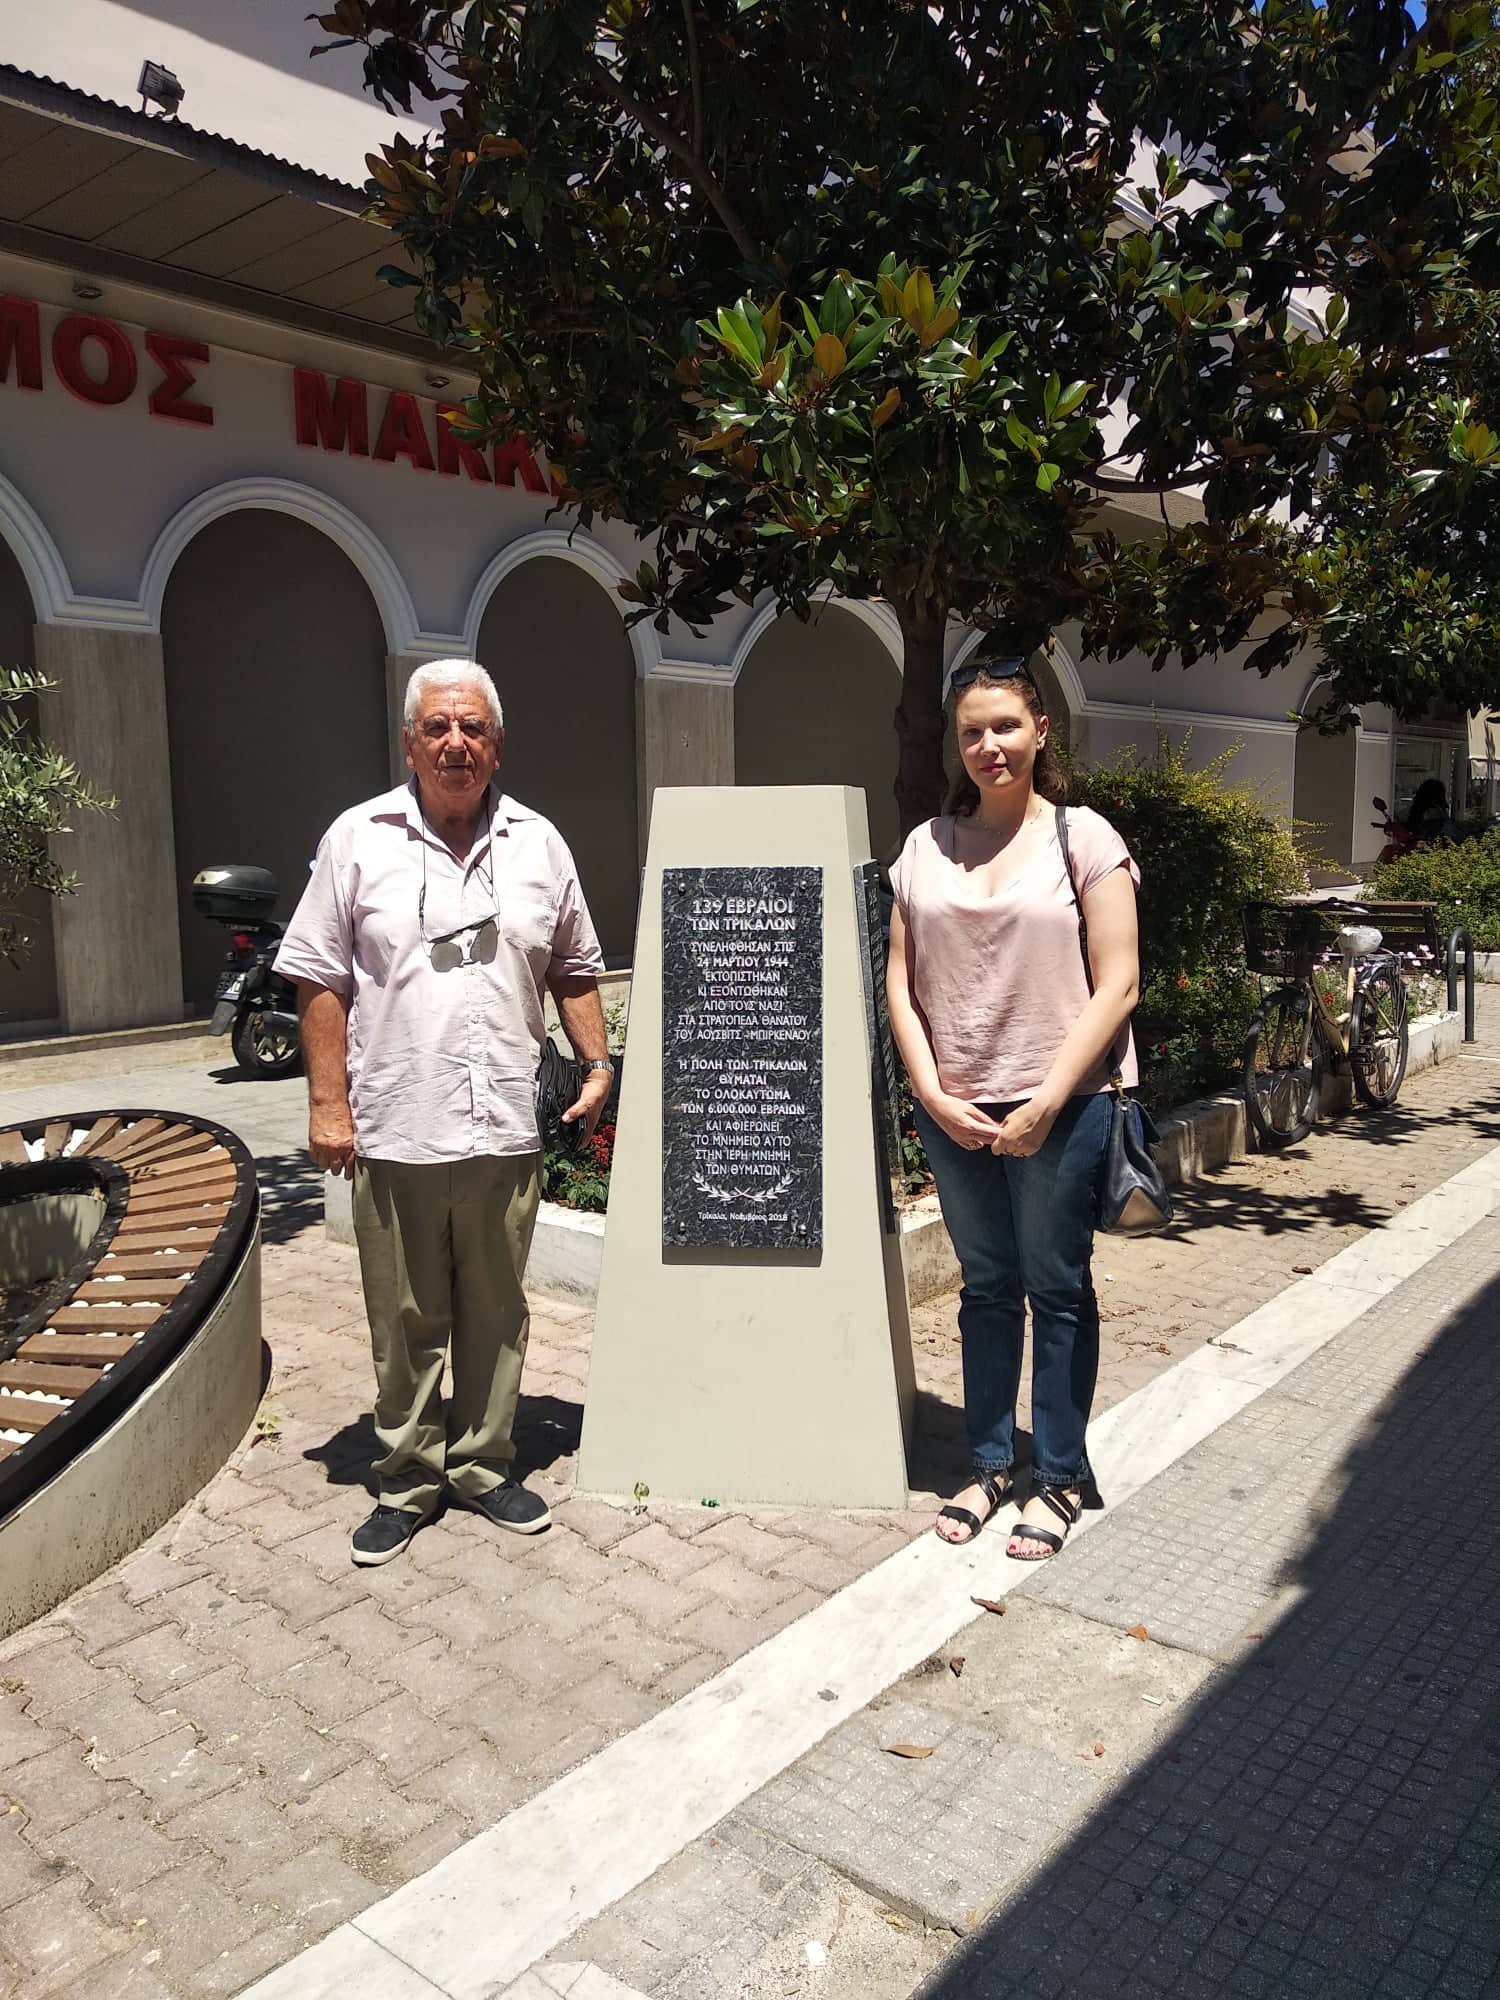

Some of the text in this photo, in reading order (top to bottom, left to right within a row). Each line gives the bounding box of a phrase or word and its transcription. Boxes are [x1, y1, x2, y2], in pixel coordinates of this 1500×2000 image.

[693, 898, 793, 914] 139 ΕΒΡΑΙΟΙ
[691, 918, 796, 930] ΤΩΝ ΤΡΙΚΑΛΩΝ
[690, 941, 795, 952] ΣΥΝΕΛΗΦΘΗΣΑΝ ΣΤΙΣ
[697, 957, 789, 967] 24 ΜΑΡΤΙΟΥ 1944
[705, 971, 780, 982] ΕΚΤΟΠΙΣΤΗΚΑΝ
[697, 986, 788, 996] ΚΙ ΕΞΟΝΤΩΘΗΚΑΝ
[703, 1000, 783, 1011] ΑΠΟ ΤΟΥΣ ΝΑΖΙ
[678, 1015, 808, 1026] ΣΤΑ ΣΤΡΑΤΟΠΕΔΑ ΘΑΝΑΤΟΥ
[675, 1029, 693, 1040] ΤΟΥ
[697, 1029, 742, 1040] ΑΟΥΣΒΙΤΣ
[678, 1059, 807, 1070] Η ΠΟΛΗ ΤΩΝ ΤΡΙΚΑΛΩΝ
[719, 1074, 767, 1085] ΘΥΜΑΤΑΙ
[695, 1089, 791, 1100] ΤΟ ΟΛΟΚΑΥΤΩΜΑ
[682, 1103, 805, 1114] ΤΩΝ 6.000.000 ΕΒΡΑΙΩΝ
[706, 1121, 780, 1132] ΚΑΙ ΑΦΙΕΡΩΝΕΙ
[696, 1136, 791, 1146] ΤΟ ΜΝΗΜΕΙΟ ΑΥΤΟ
[695, 1150, 791, 1160] ΣΤΗΝ ΙΕΡΗ ΜΝΗΜΗ
[706, 1164, 781, 1175] ΤΩΝ ΘΥΜΑΤΩΝ
